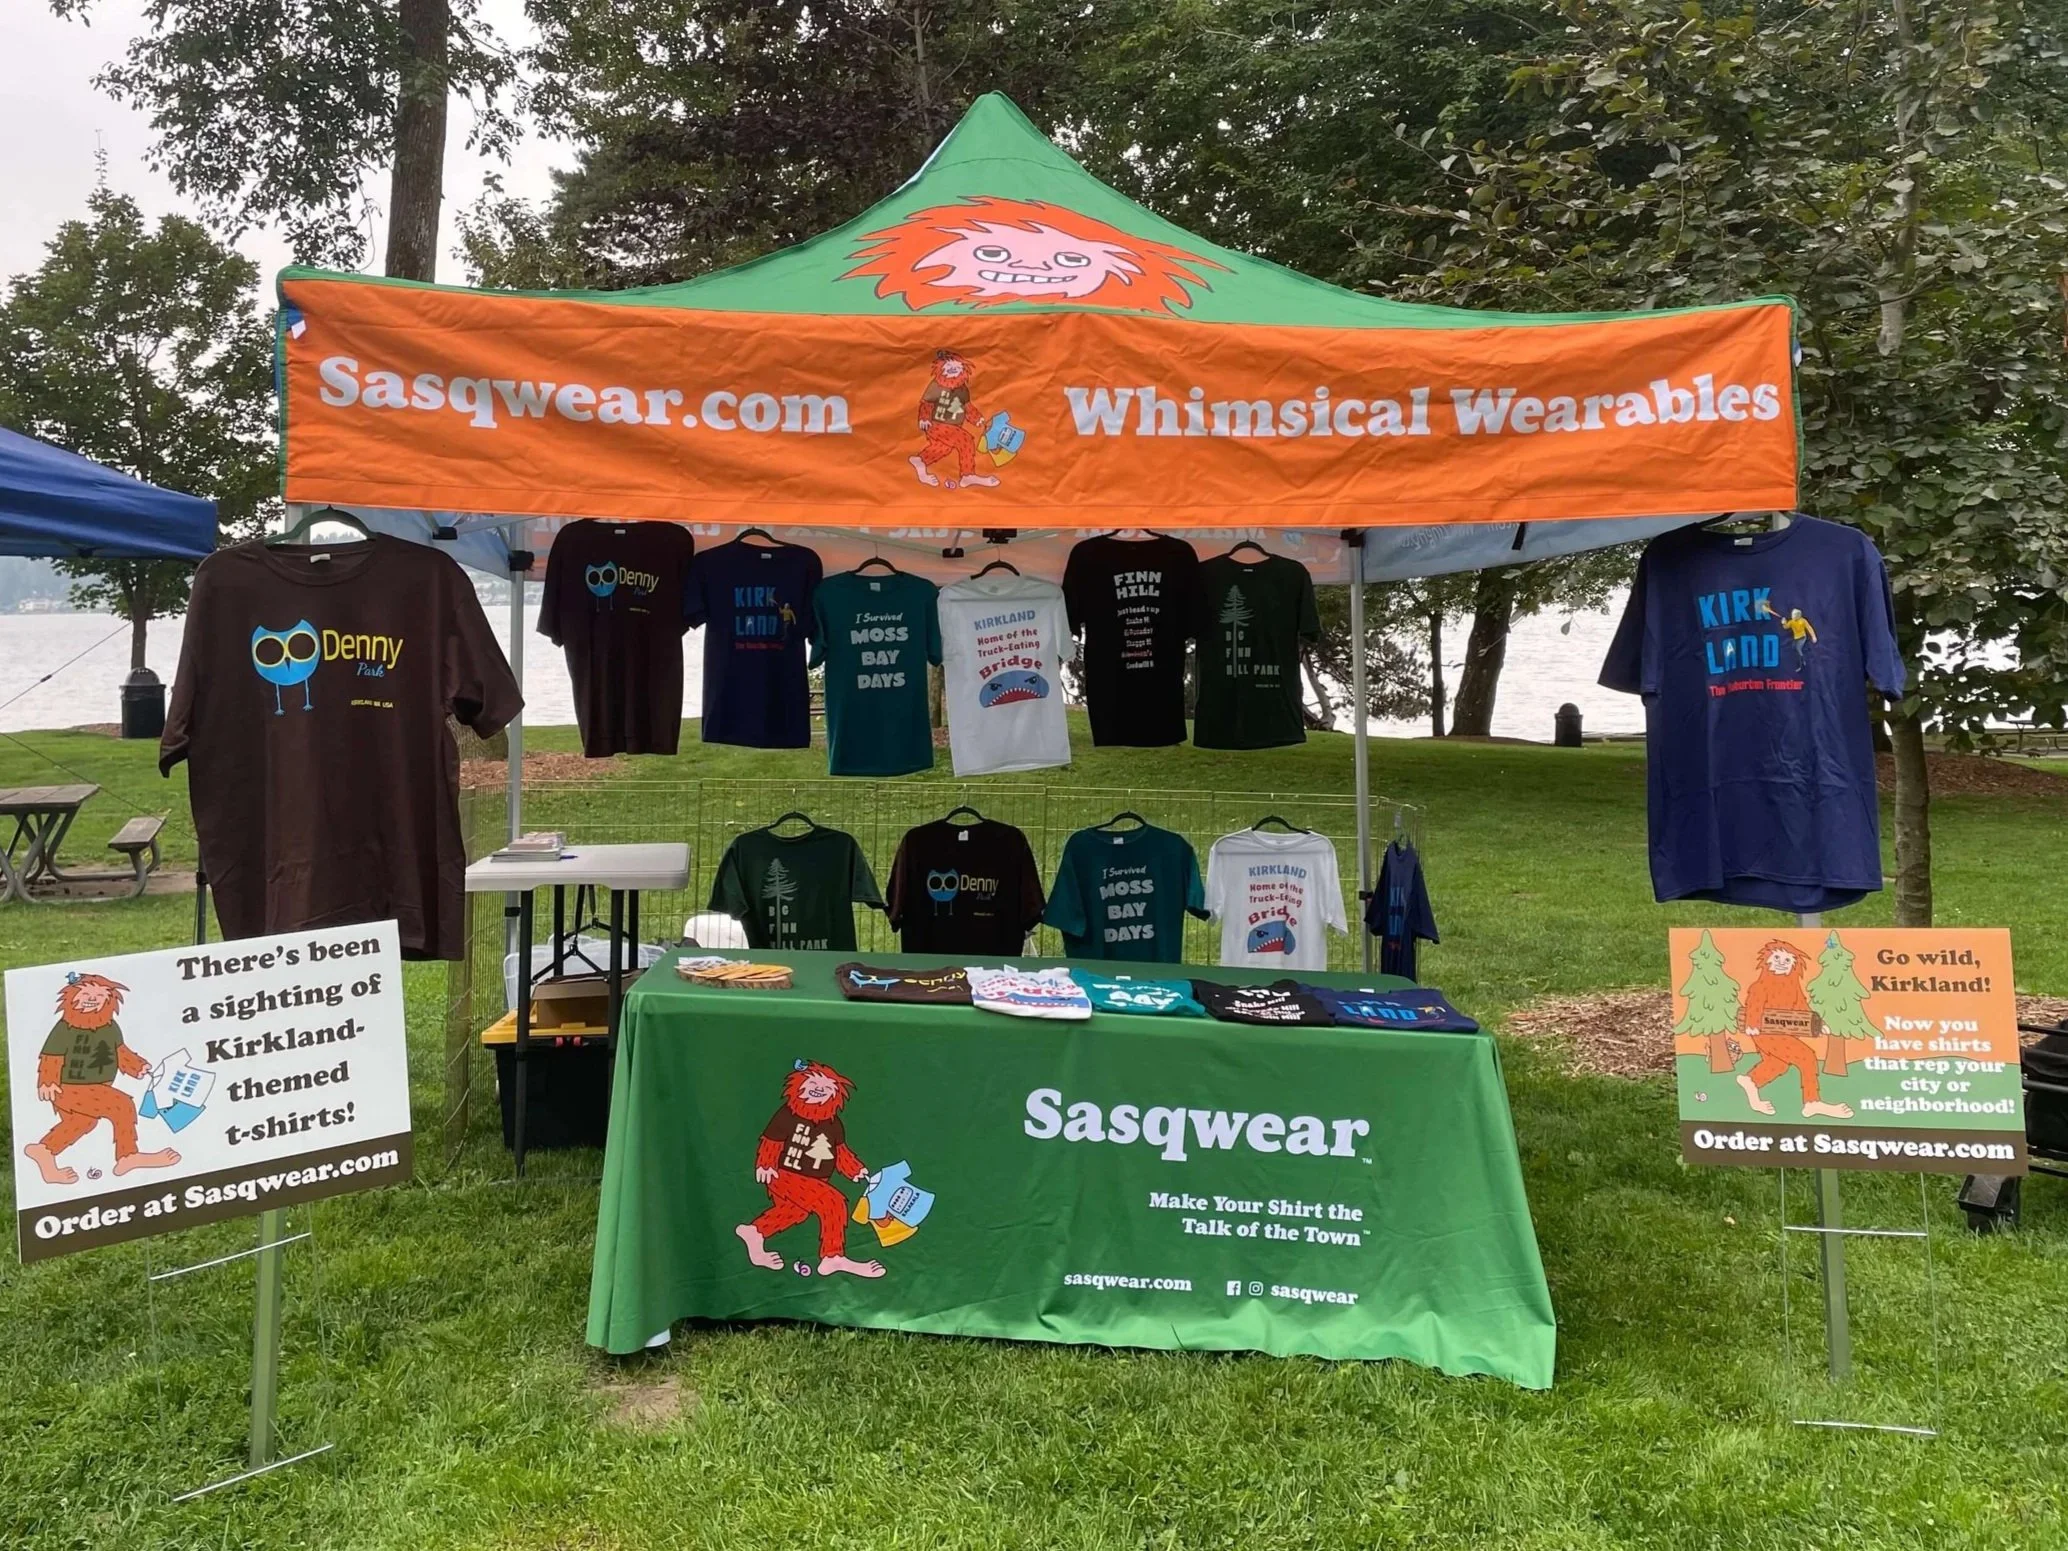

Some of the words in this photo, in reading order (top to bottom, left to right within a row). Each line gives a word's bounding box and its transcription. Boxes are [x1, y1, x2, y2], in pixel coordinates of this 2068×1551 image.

[319, 356, 852, 435] Sasqwear.com
[1064, 387, 1430, 437] Whimsical
[1450, 373, 1780, 435] Wearables
[619, 567, 659, 593] Denny
[1114, 571, 1162, 587] FINN
[735, 587, 776, 607] KIRK
[1116, 584, 1160, 600] HILL
[856, 613, 862, 624] I
[863, 612, 903, 623] Survived
[1698, 587, 1772, 629] KIRK
[735, 615, 778, 636] LAND
[974, 610, 1036, 631] KIRKLAND
[850, 627, 909, 645] MOSS
[977, 635, 1004, 646] Home
[1006, 631, 1018, 640] of
[1021, 628, 1038, 637] the
[322, 629, 404, 669] Denny
[861, 650, 900, 666] BAY
[977, 640, 1040, 658] Truck-Eating
[1706, 634, 1780, 675] LAND
[356, 661, 385, 678] Park
[979, 655, 1042, 680] Bridge
[1253, 664, 1280, 675] PARK
[857, 672, 906, 689] DAYS
[1102, 868, 1108, 879] I
[1109, 865, 1147, 877] Survived
[1248, 864, 1307, 879] KIRKLAND
[960, 874, 999, 896] Denny
[1099, 879, 1154, 900] MOSS
[1250, 883, 1276, 892] Home
[1107, 902, 1147, 920] BAY
[1104, 924, 1155, 942] DAYS
[177, 946, 299, 980] There's
[308, 937, 381, 962] been
[1877, 949, 1910, 967] Go
[1916, 950, 1981, 969] wild,
[1871, 975, 1991, 993] Kirkland!
[182, 1007, 200, 1023] a
[210, 983, 343, 1021] sighting
[351, 974, 382, 996] of
[1342, 1005, 1418, 1021] LAND
[1764, 1017, 1810, 1030] Sasqwear
[1885, 1016, 1933, 1032] Now
[1939, 1019, 1978, 1034] you
[205, 1018, 365, 1064] Kirkland-
[1875, 1036, 1923, 1052] have
[1928, 1037, 1992, 1053] shirts
[1864, 1057, 1909, 1072] that
[1913, 1060, 1950, 1076] rep
[1955, 1061, 2006, 1076] your
[168, 1070, 187, 1093] KIRK
[227, 1062, 350, 1102] themed
[1900, 1078, 1942, 1094] city
[1947, 1080, 1971, 1093] or
[1861, 1097, 2015, 1114] neighborhood!
[225, 1102, 356, 1146] t-shirts!
[1024, 1088, 1370, 1162] Sasqwear
[1694, 1129, 1773, 1152] Order
[1780, 1134, 1808, 1152] at
[1814, 1133, 2015, 1161] Sasqwear.com
[35, 1205, 136, 1240] Order
[144, 1196, 177, 1217] at
[185, 1147, 400, 1209] Sasqwear.com
[1149, 1192, 1208, 1212] Make
[1213, 1195, 1263, 1214] Your
[1267, 1199, 1323, 1219] Shirt
[1328, 1203, 1363, 1222] the
[1182, 1218, 1232, 1237] Talk
[1236, 1221, 1259, 1238] of
[1264, 1223, 1299, 1242] the
[1304, 1226, 1361, 1247] Town
[1064, 1272, 1192, 1292] sasqwear.com
[1270, 1283, 1358, 1305] sasqwear
